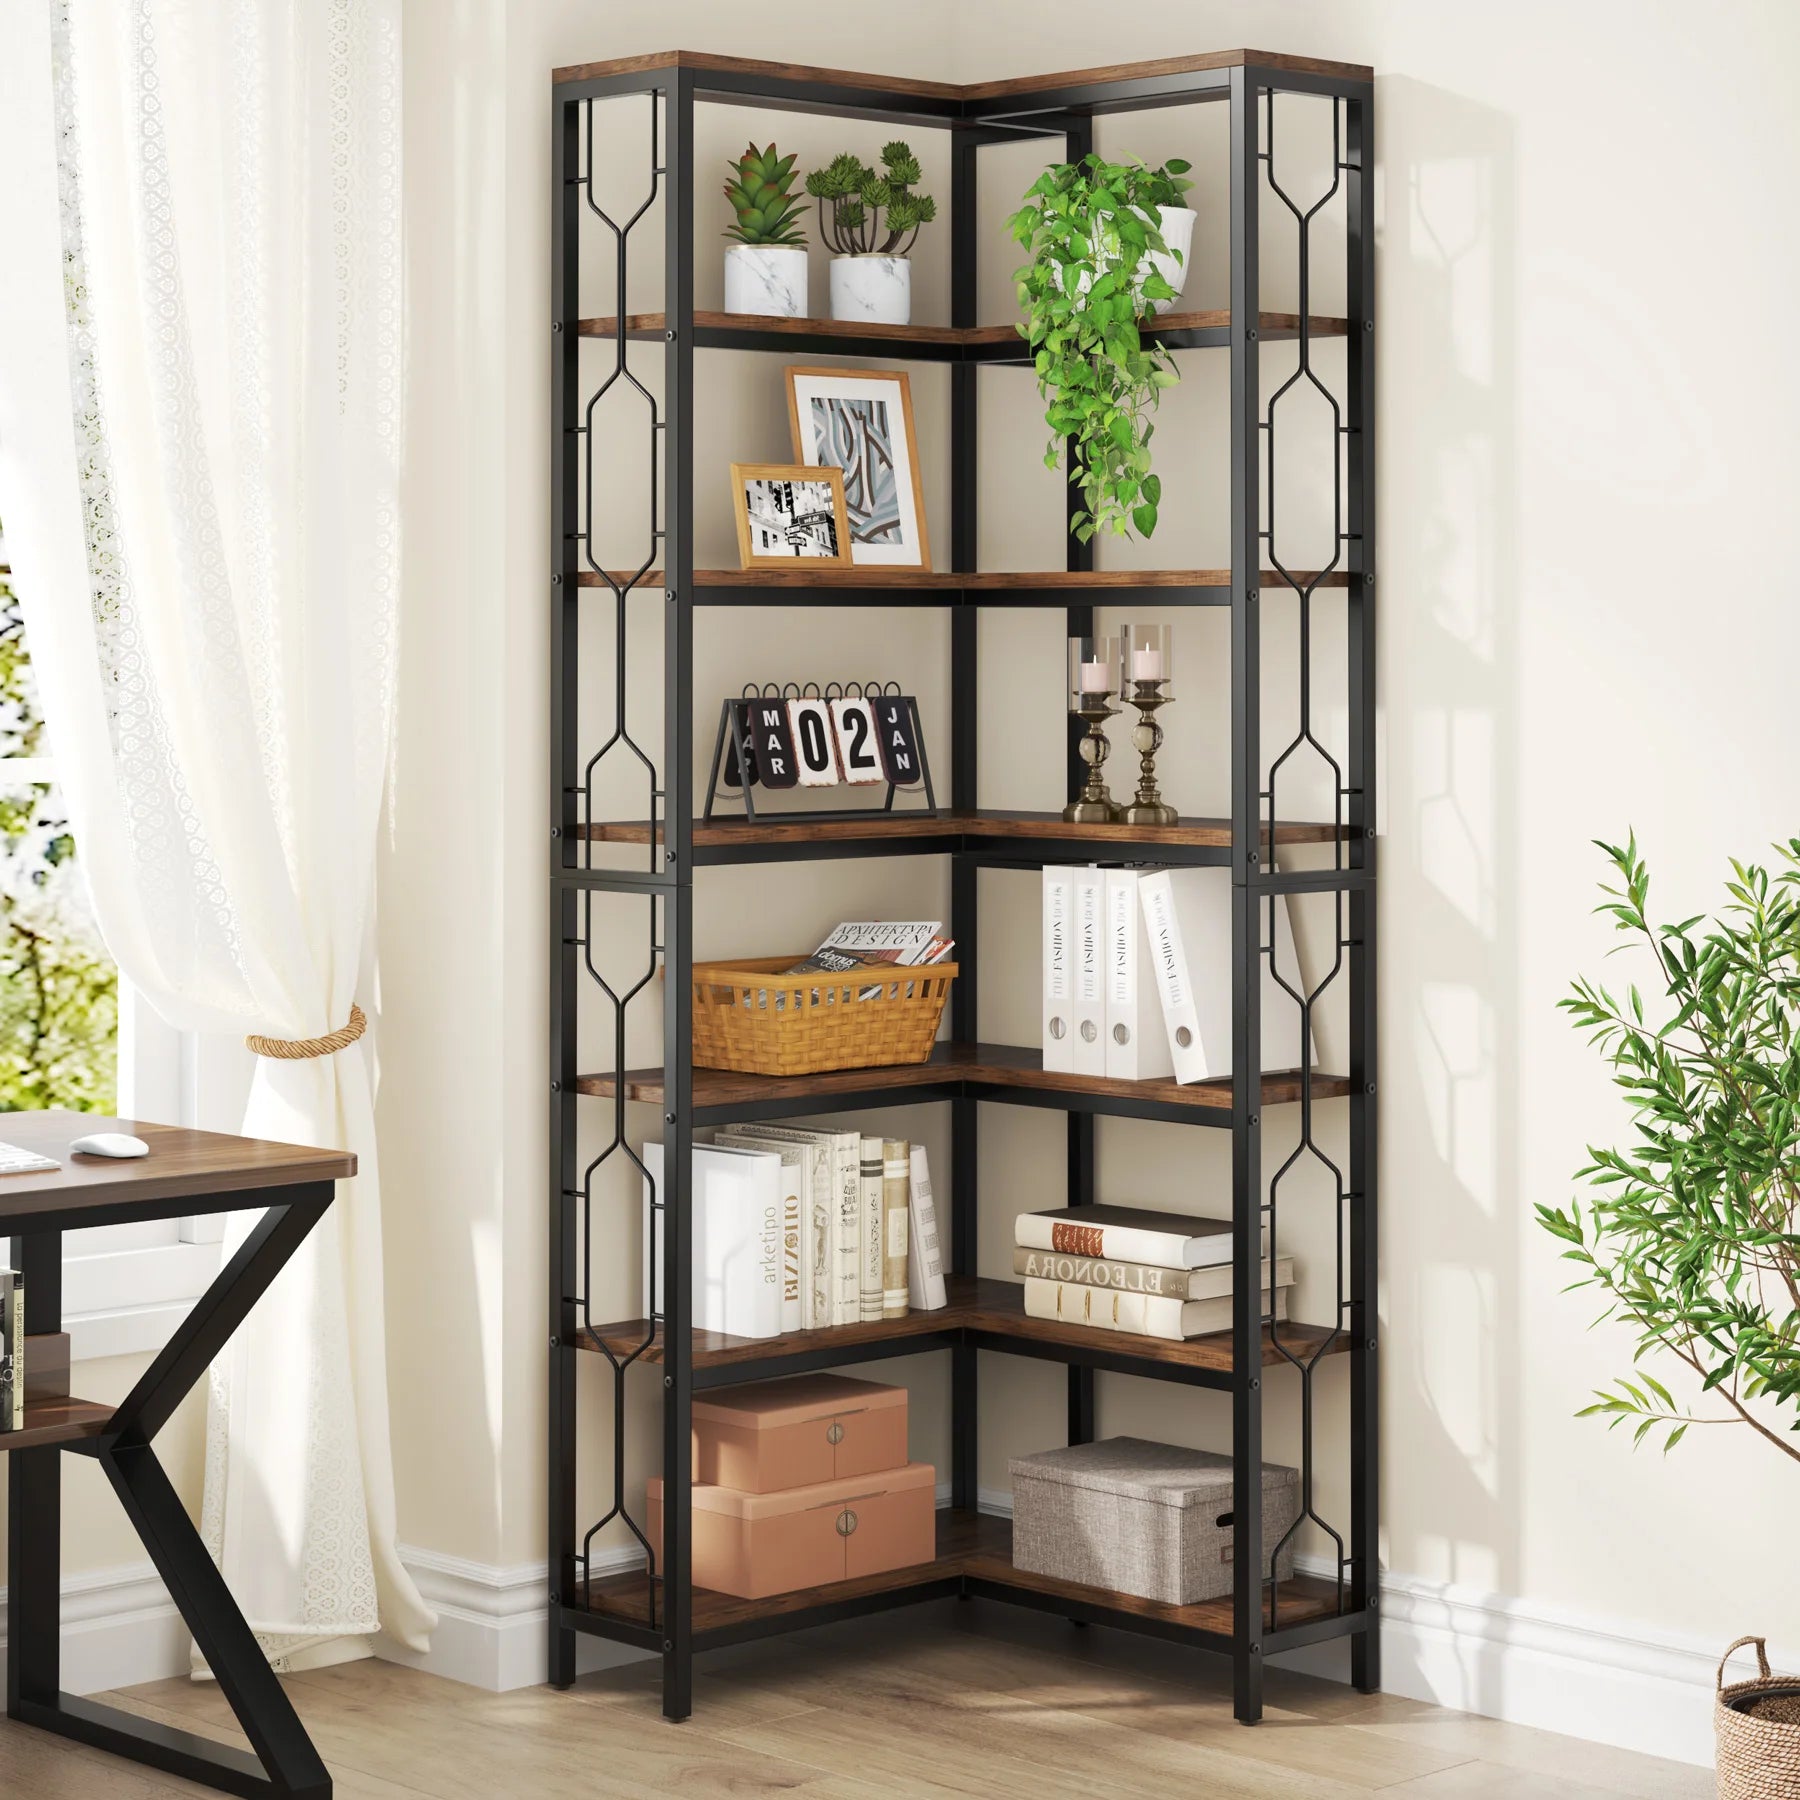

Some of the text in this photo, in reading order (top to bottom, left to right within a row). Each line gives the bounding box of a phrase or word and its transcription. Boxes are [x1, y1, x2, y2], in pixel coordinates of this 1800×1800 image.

[762, 709, 786, 775] MAR
[887, 707, 911, 770] JAN
[818, 949, 857, 967] domus
[833, 934, 925, 946] DESIGN
[1053, 921, 1063, 971] FASHION
[1084, 923, 1094, 973] FASHION
[1116, 926, 1126, 976] FASHION
[1160, 928, 1177, 979] FASHION
[1053, 973, 1063, 997] THE
[1084, 975, 1094, 999] THE
[759, 1206, 780, 1284] arketipo
